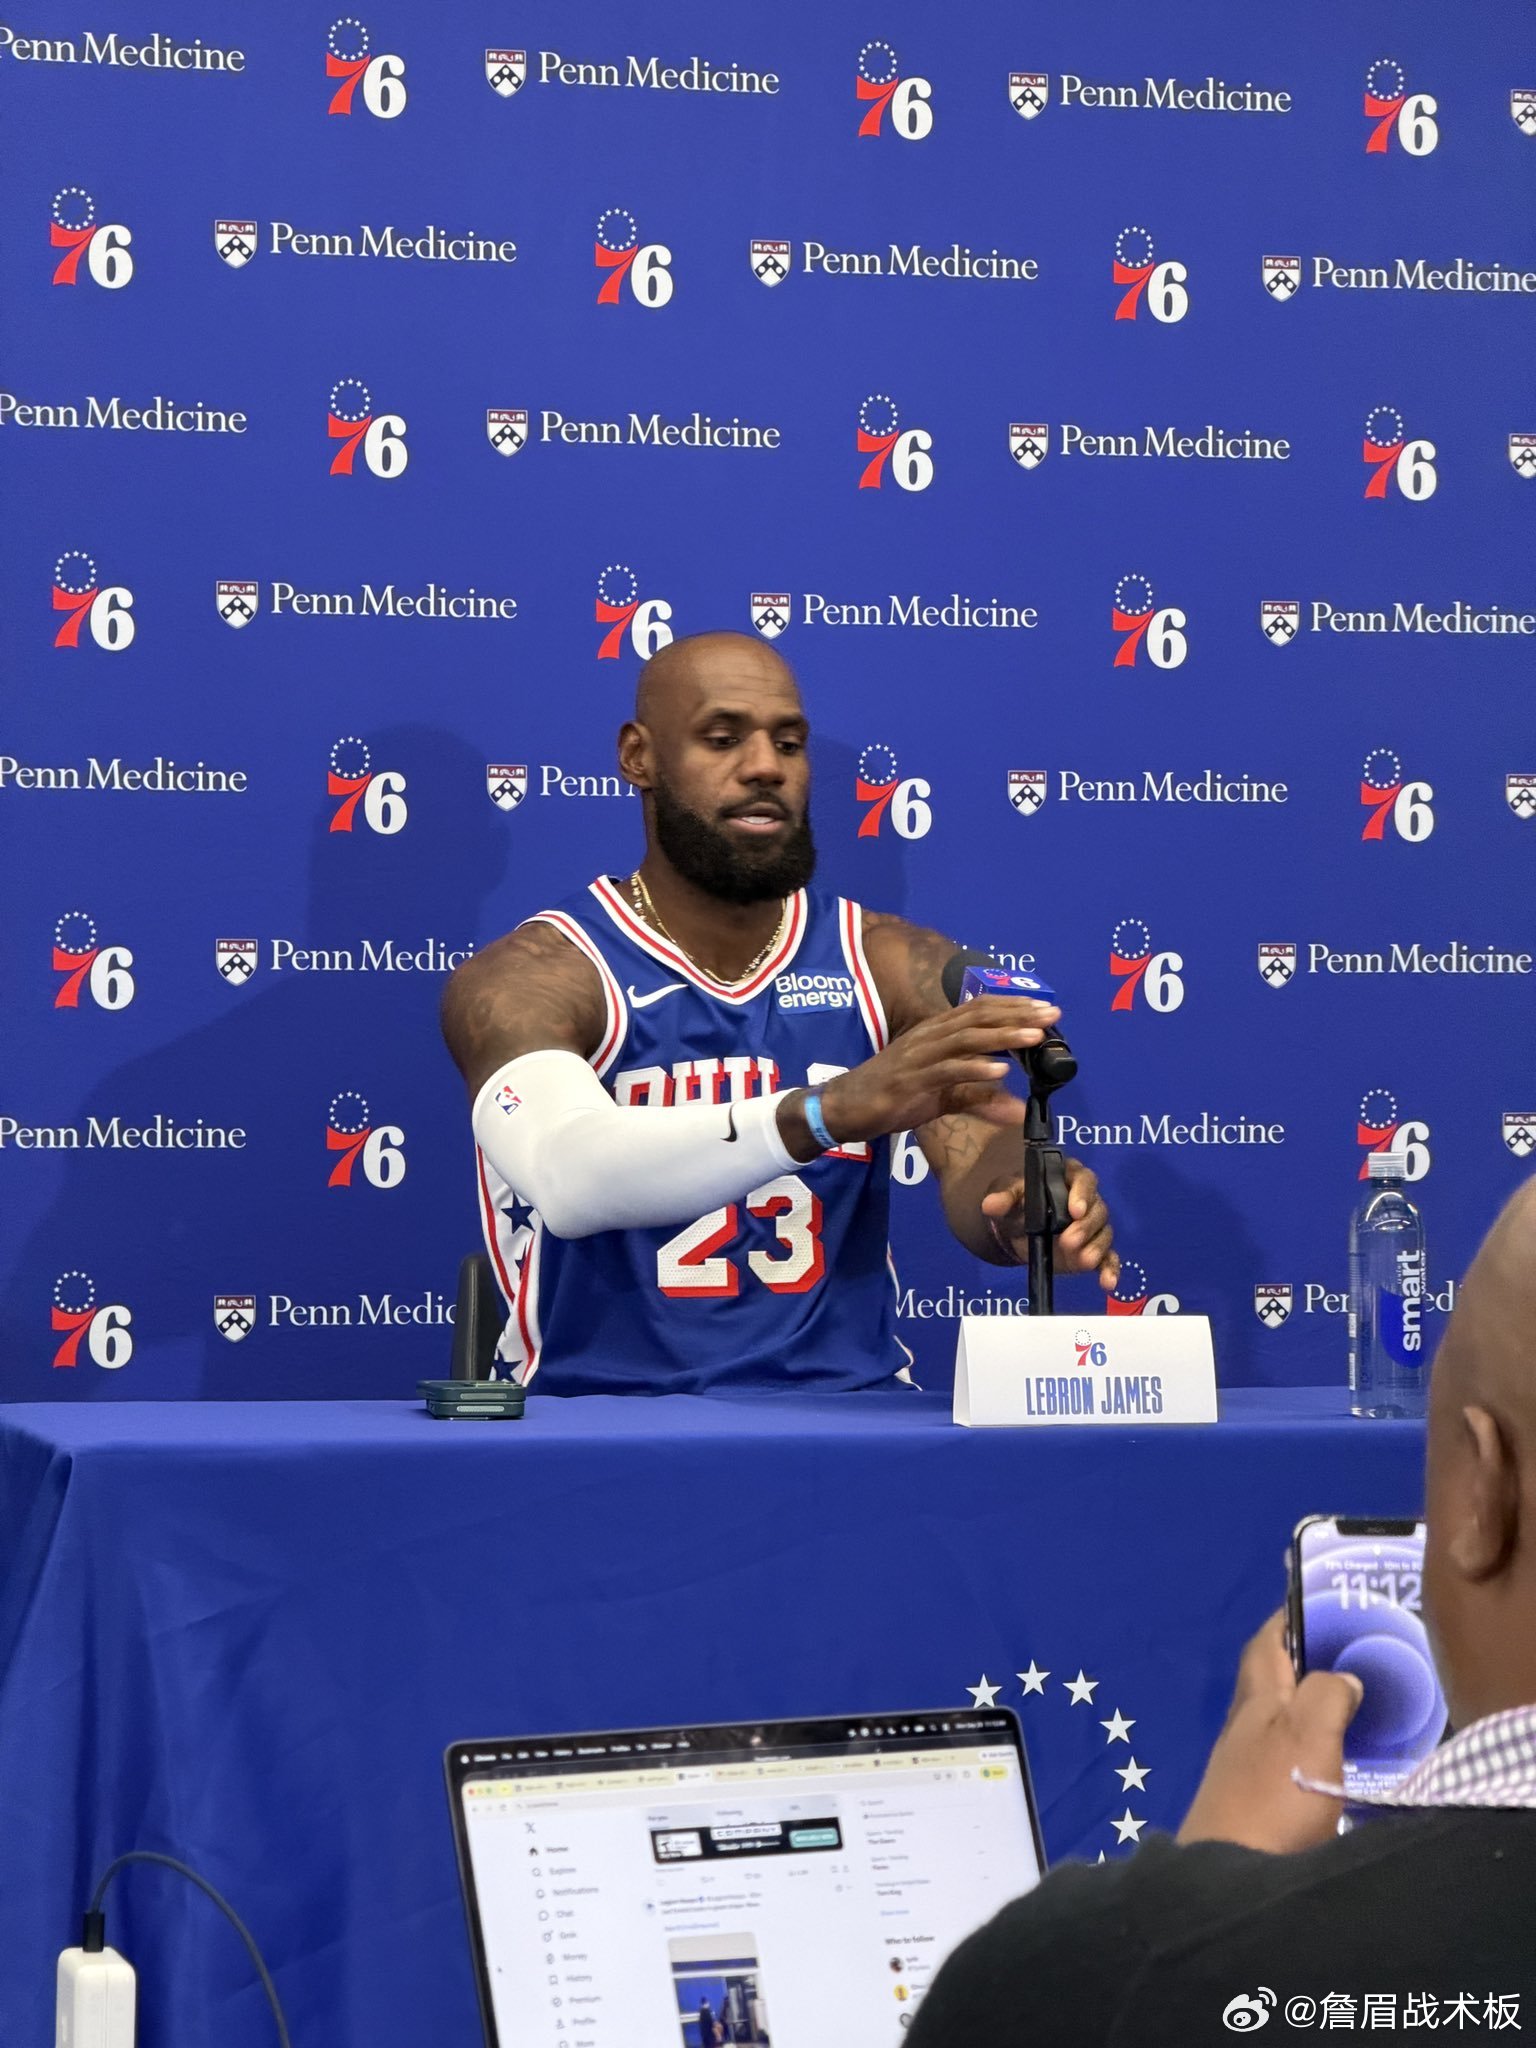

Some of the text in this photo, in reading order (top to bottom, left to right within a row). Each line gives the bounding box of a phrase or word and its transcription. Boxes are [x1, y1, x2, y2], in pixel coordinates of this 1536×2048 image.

[0, 26, 246, 72] Penn Medicine
[326, 52, 407, 119] 76
[539, 52, 780, 95] Penn Medicine
[1061, 75, 1292, 113] Penn Medicine
[856, 75, 934, 140] 76
[1364, 93, 1440, 157] 76
[50, 222, 134, 290] 76
[270, 222, 518, 263] Penn Medicine
[803, 242, 1039, 280] Penn Medicine
[595, 242, 674, 309] 76
[1113, 260, 1189, 324] 76
[1313, 257, 1536, 293] Penn Medicine
[0, 393, 248, 434] Penn Medicine
[541, 410, 781, 449] Penn Medicine
[328, 412, 408, 479] 76
[857, 428, 934, 492] 76
[1061, 424, 1291, 460] Penn Medicine
[1363, 438, 1439, 502] 76
[53, 585, 136, 652] 76
[272, 582, 518, 619] Penn Medicine
[803, 593, 1038, 628] Penn Medicine
[1311, 601, 1536, 635] Penn Medicine
[595, 598, 675, 662] 76
[1112, 606, 1189, 670] 76
[0, 756, 248, 792] Penn Medicine
[541, 765, 622, 797] Penn
[1059, 770, 1288, 803] Penn Medicine
[328, 770, 408, 835] 76
[856, 776, 934, 840] 76
[1361, 781, 1436, 843] 76
[271, 939, 475, 972] Penn Medic
[1308, 942, 1533, 974] Penn Medicine
[53, 945, 136, 1011] 76
[775, 972, 852, 993] Bloom
[778, 989, 854, 1008] energy
[1110, 951, 1186, 1013] 76
[0, 1115, 247, 1149] Penn Medicine
[1056, 1112, 1285, 1145] Penn Medicine
[327, 1125, 407, 1189] 76
[657, 1174, 825, 1298] 23
[269, 1291, 457, 1326] Penn Medic
[896, 1285, 1029, 1319] Medicine
[1396, 1249, 1422, 1352] smart
[51, 1305, 134, 1370] 76
[1075, 1341, 1107, 1367] 76
[1025, 1376, 1163, 1416] LEBRON JAMES
[1331, 1572, 1422, 1611] 11:12
